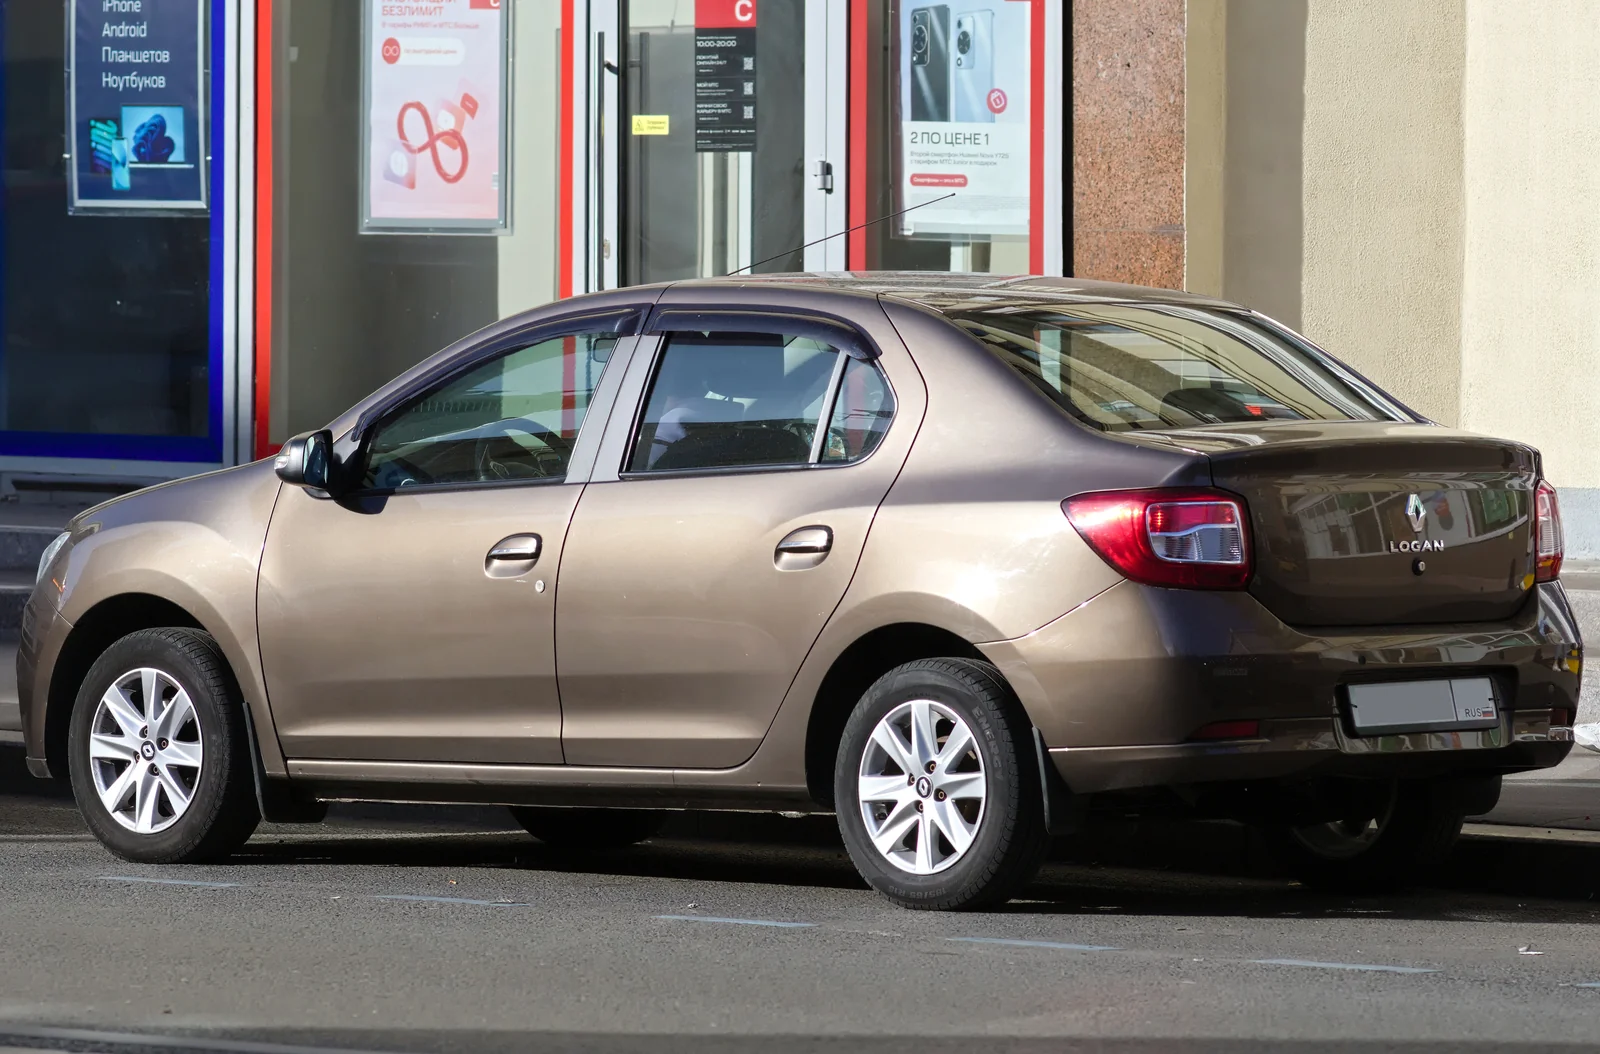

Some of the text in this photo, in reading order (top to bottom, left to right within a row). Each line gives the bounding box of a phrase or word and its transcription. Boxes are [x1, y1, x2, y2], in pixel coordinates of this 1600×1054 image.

[102, 0, 141, 12] iPhone
[381, 6, 444, 16] БЕЗЛИМИТ
[102, 21, 147, 37] Android
[102, 46, 170, 63] Планшетов
[102, 71, 166, 91] Ноутбуков
[910, 131, 989, 147] 2 ПО ЦЕНЕ 1
[1389, 540, 1445, 553] LOGAN
[1464, 708, 1482, 718] RUS
